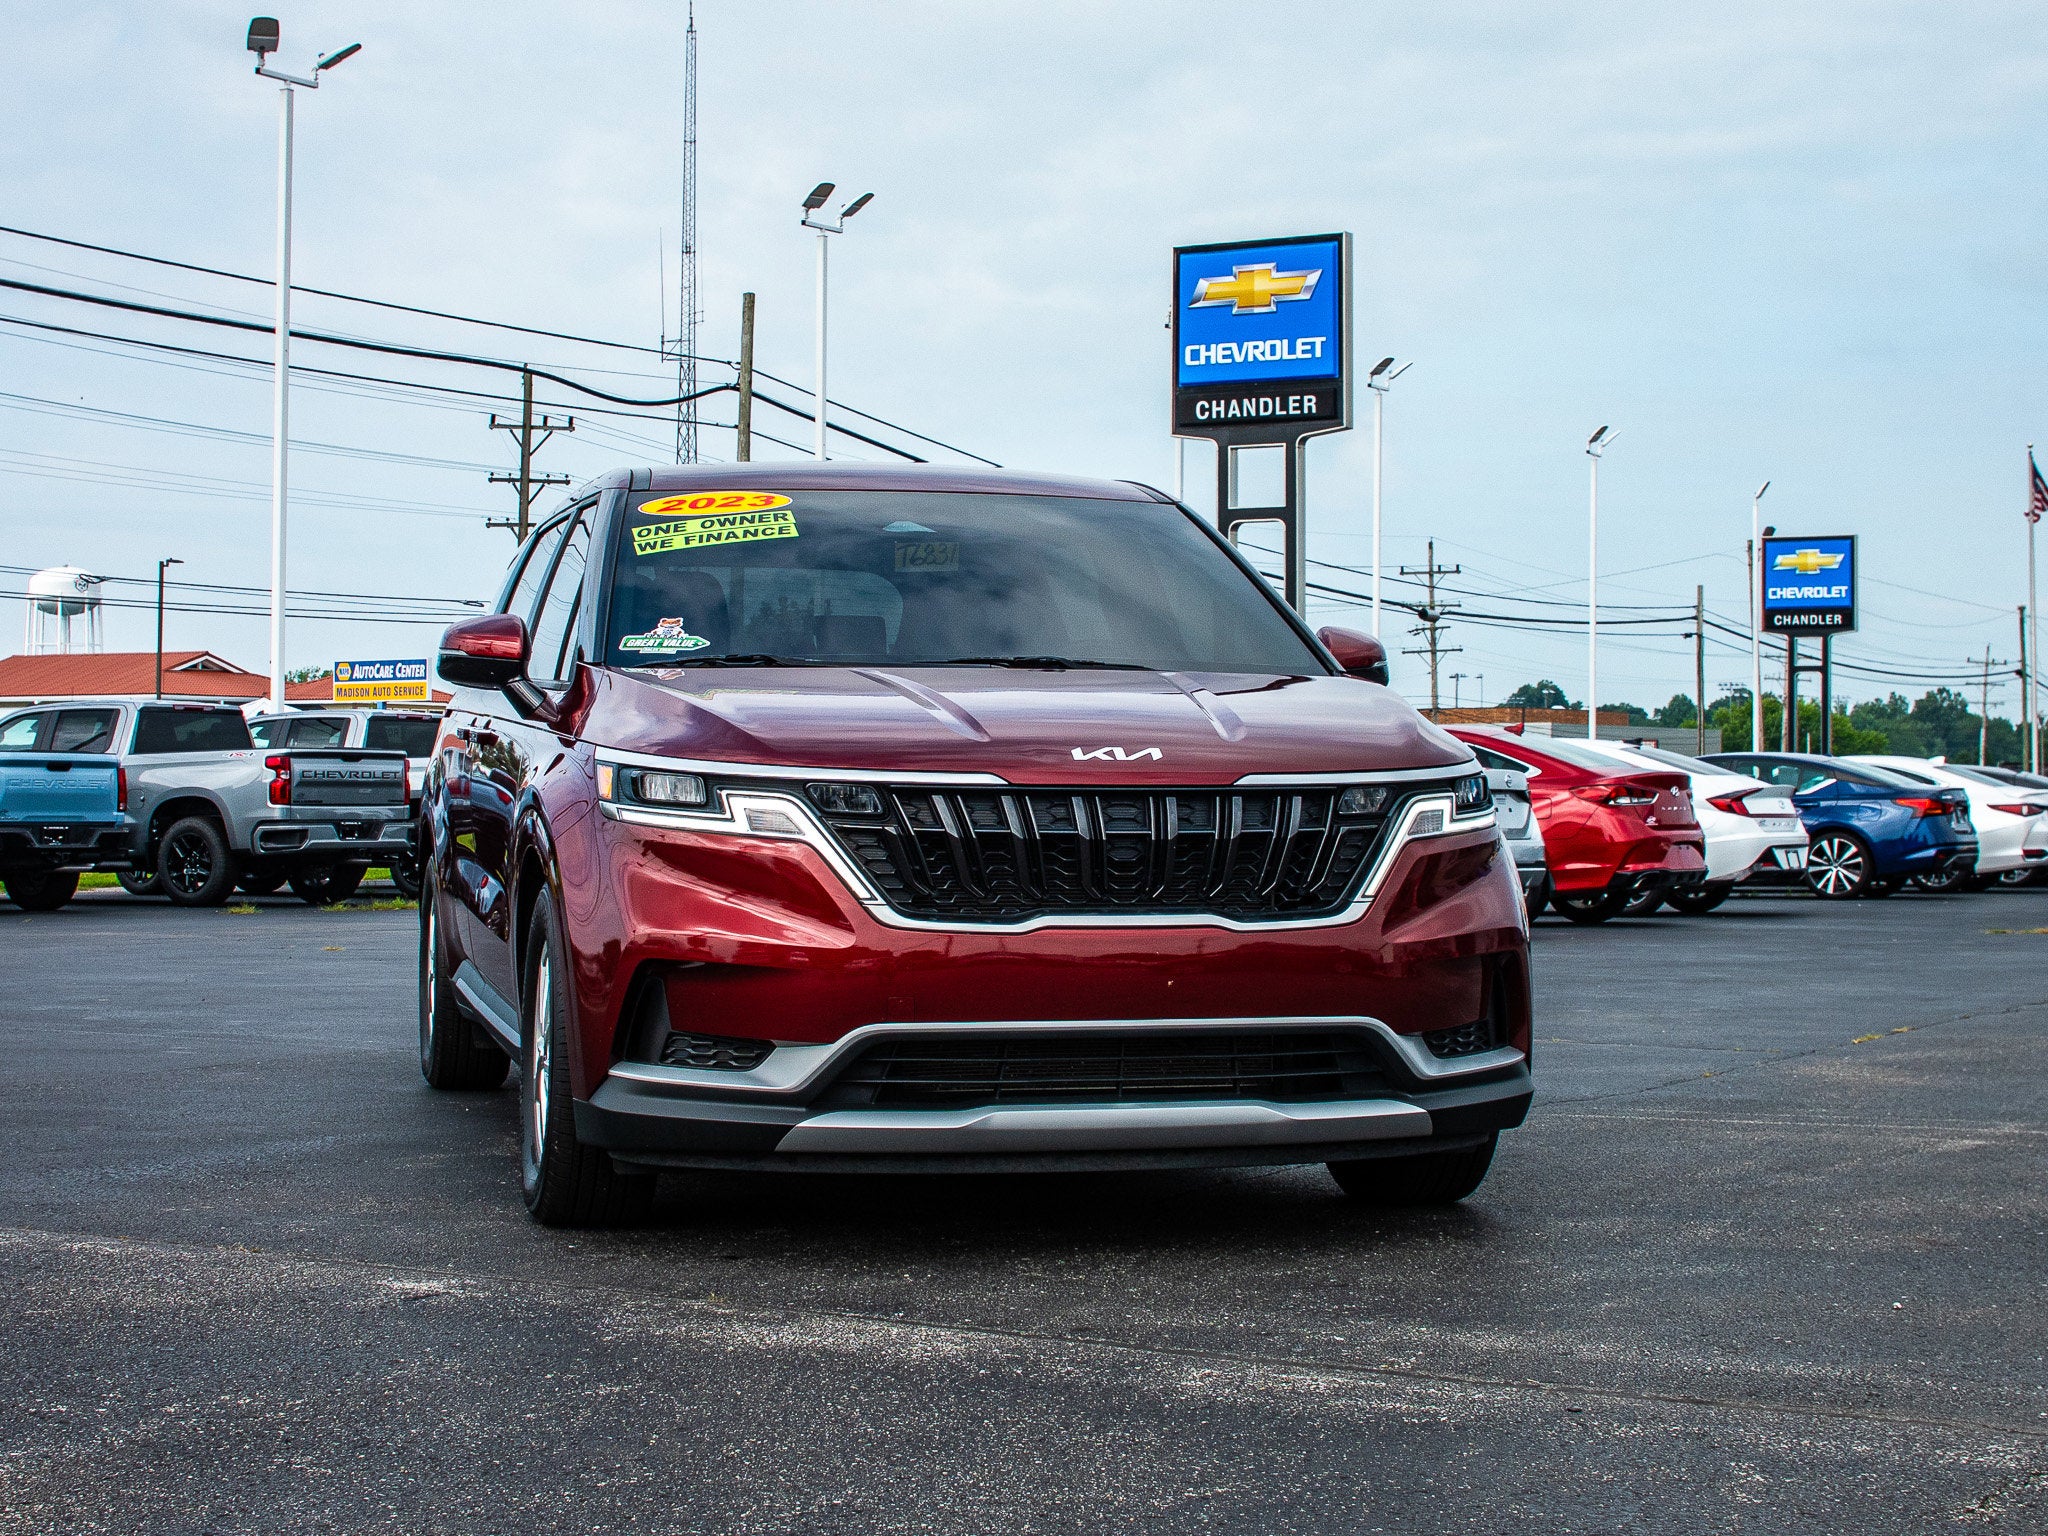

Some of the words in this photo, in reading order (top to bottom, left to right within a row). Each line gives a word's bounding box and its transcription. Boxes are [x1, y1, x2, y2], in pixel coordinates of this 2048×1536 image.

[1185, 336, 1327, 366] CHEVROLET
[1195, 395, 1317, 420] CHANDLER
[656, 495, 776, 513] 2023
[637, 522, 688, 538] ONE
[700, 512, 790, 530] OWNER
[637, 538, 674, 552] WE
[684, 525, 791, 546] FINANCE
[1768, 586, 1848, 599] CHEVROLET
[1773, 614, 1842, 626] CHANDLER
[626, 639, 661, 647] GREAT
[662, 639, 697, 647] VALUE
[336, 687, 370, 697] MADISON
[372, 686, 391, 697] AUTO
[393, 685, 424, 697] SERVICE
[301, 770, 400, 780] CHEVROLET
